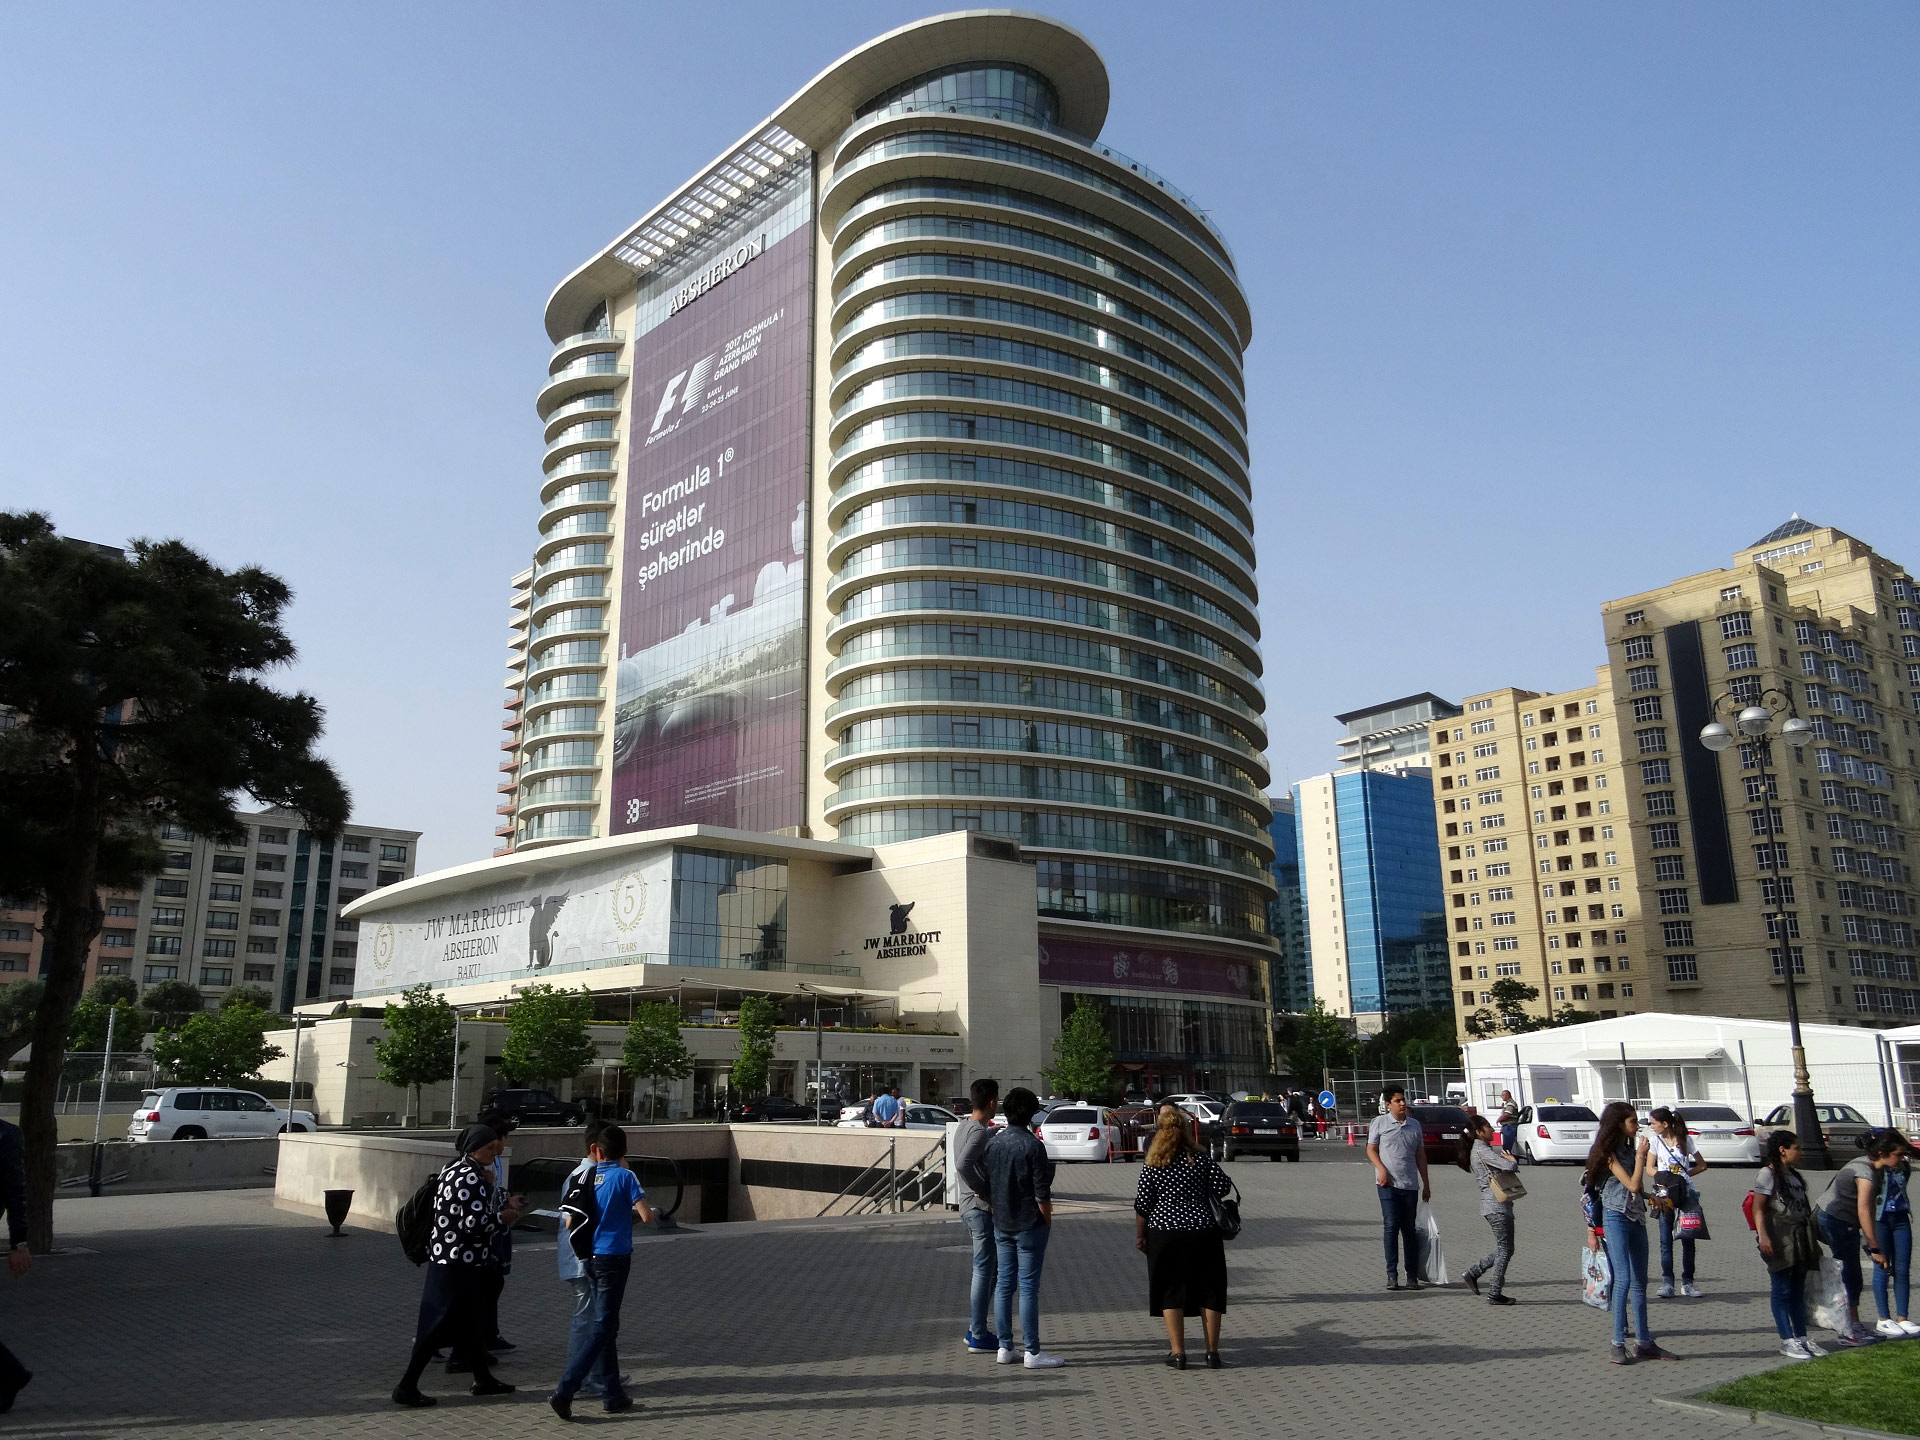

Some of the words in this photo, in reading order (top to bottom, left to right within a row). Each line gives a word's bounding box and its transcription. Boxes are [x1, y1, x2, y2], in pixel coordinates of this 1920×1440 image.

[669, 233, 766, 317] ABSHERON
[725, 335, 742, 353] 2017
[743, 312, 778, 342] FORMULA
[780, 308, 785, 318] 1
[714, 359, 740, 381] GRAND
[741, 347, 759, 365] PRIX
[718, 333, 762, 368] AZERBAIJAN
[706, 385, 723, 400] BAKU
[725, 385, 739, 400] JUNE
[641, 464, 711, 519] Formula
[640, 502, 706, 551] sürətlər
[638, 526, 725, 592] şəhərində
[624, 885, 635, 914] 5
[424, 916, 446, 941] JW
[448, 900, 525, 937] MARRIOTT
[442, 935, 500, 962] ABSHERON
[616, 941, 638, 954] YEARS
[863, 937, 881, 950] JW
[882, 930, 942, 948] MARRIOTT
[876, 944, 927, 960] ABSHERON
[457, 963, 481, 981] BAKU
